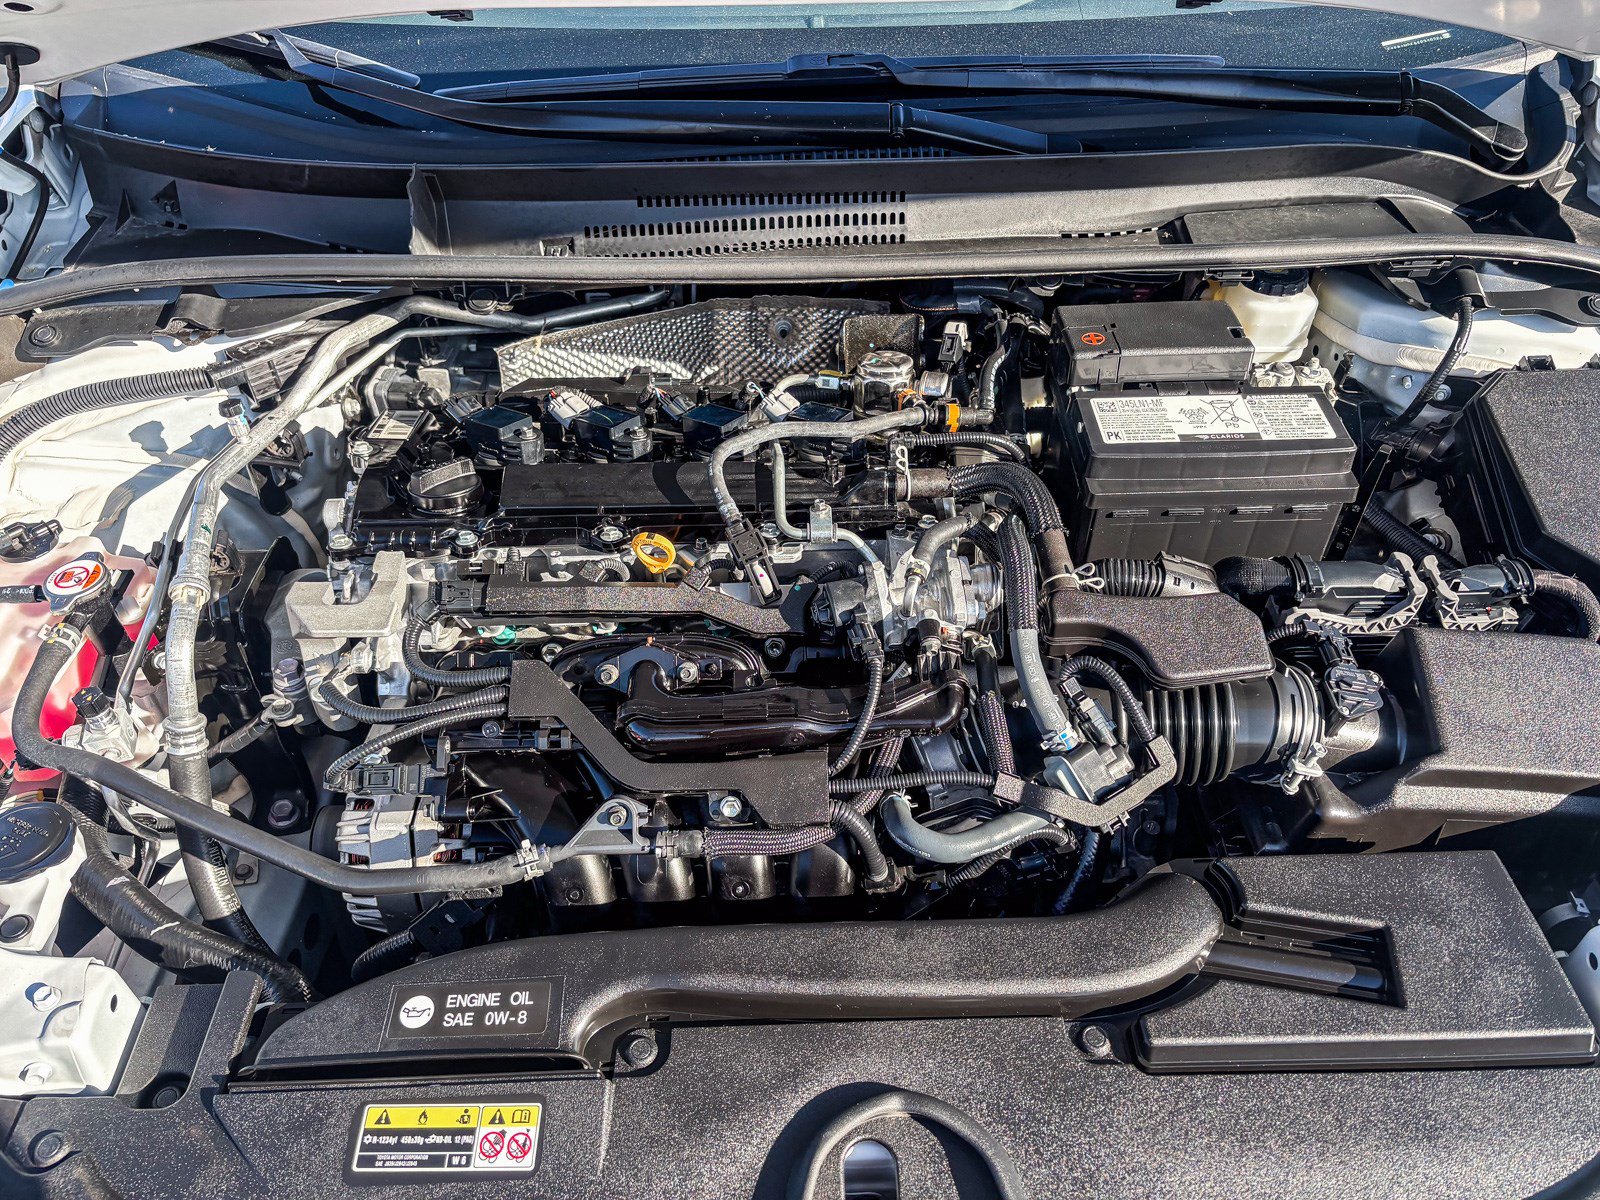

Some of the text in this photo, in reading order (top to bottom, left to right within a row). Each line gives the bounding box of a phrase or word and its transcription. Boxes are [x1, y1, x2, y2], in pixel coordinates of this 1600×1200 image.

[1119, 399, 1164, 408] 345LN1-MF
[1106, 431, 1122, 440] PK
[446, 991, 534, 1008] ENGINE OIL
[443, 1011, 528, 1027] SAE 0W-8
[452, 1155, 467, 1165] W 6
